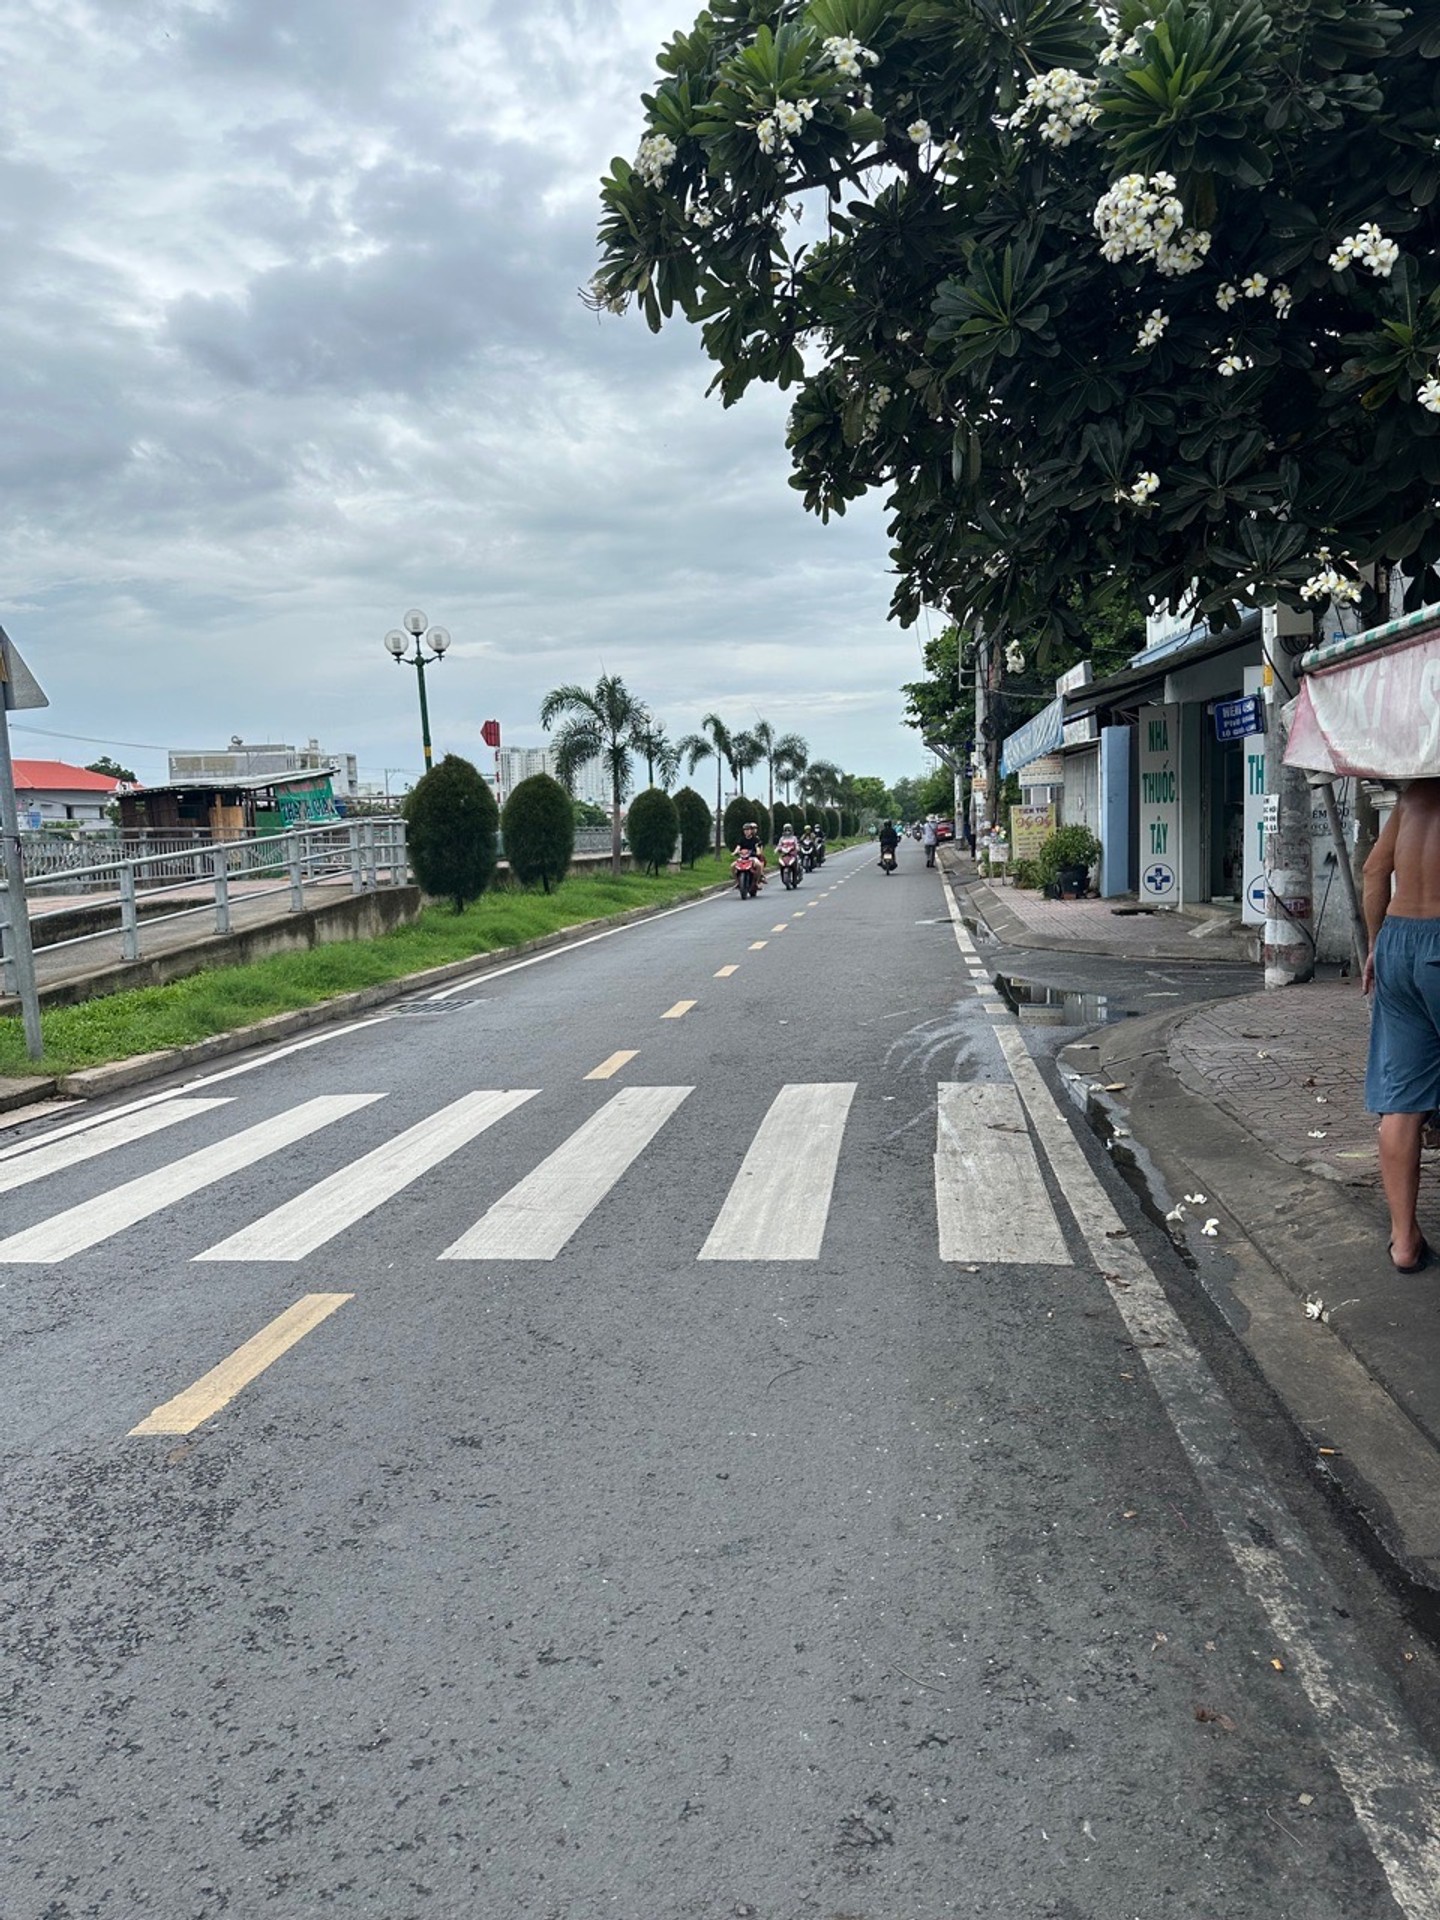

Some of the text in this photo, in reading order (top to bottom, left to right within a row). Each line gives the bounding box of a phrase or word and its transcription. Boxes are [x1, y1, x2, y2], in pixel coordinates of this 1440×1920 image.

[1148, 711, 1169, 752] NHÀ
[1142, 759, 1175, 804] THUỐC
[1150, 815, 1168, 855] TÂY
